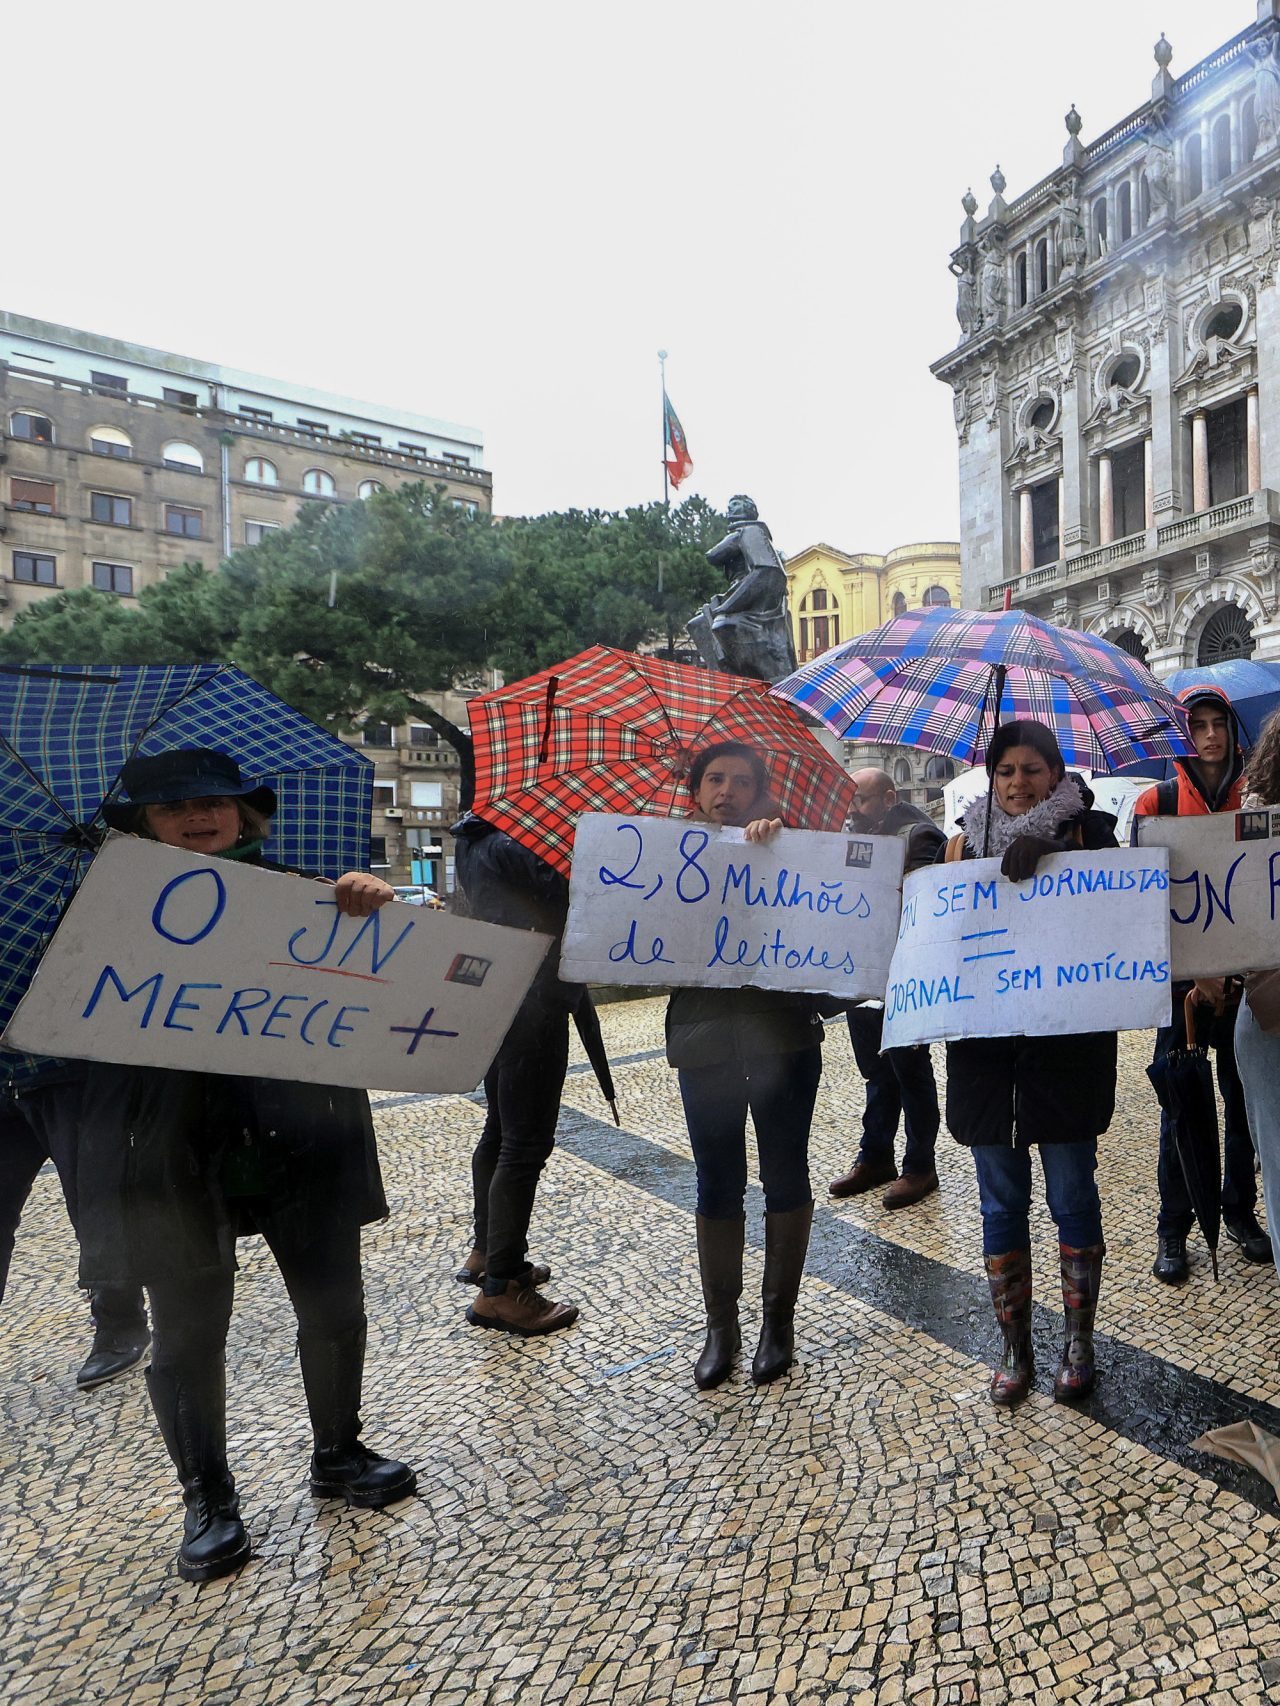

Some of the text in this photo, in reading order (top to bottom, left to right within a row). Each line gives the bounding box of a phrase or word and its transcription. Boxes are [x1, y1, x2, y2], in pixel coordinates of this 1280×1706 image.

[598, 823, 872, 920] 2,8 Milhões
[849, 842, 872, 862] JN
[151, 868, 416, 975] O JN
[899, 867, 1169, 941] JN SEM JORNALISTAS
[1169, 851, 1246, 933] JN
[456, 956, 486, 981] JN
[608, 915, 855, 976] de leitores
[82, 964, 371, 1049] MERECE
[886, 952, 1169, 1022] JORNAL SEM NOTÍCIAS
